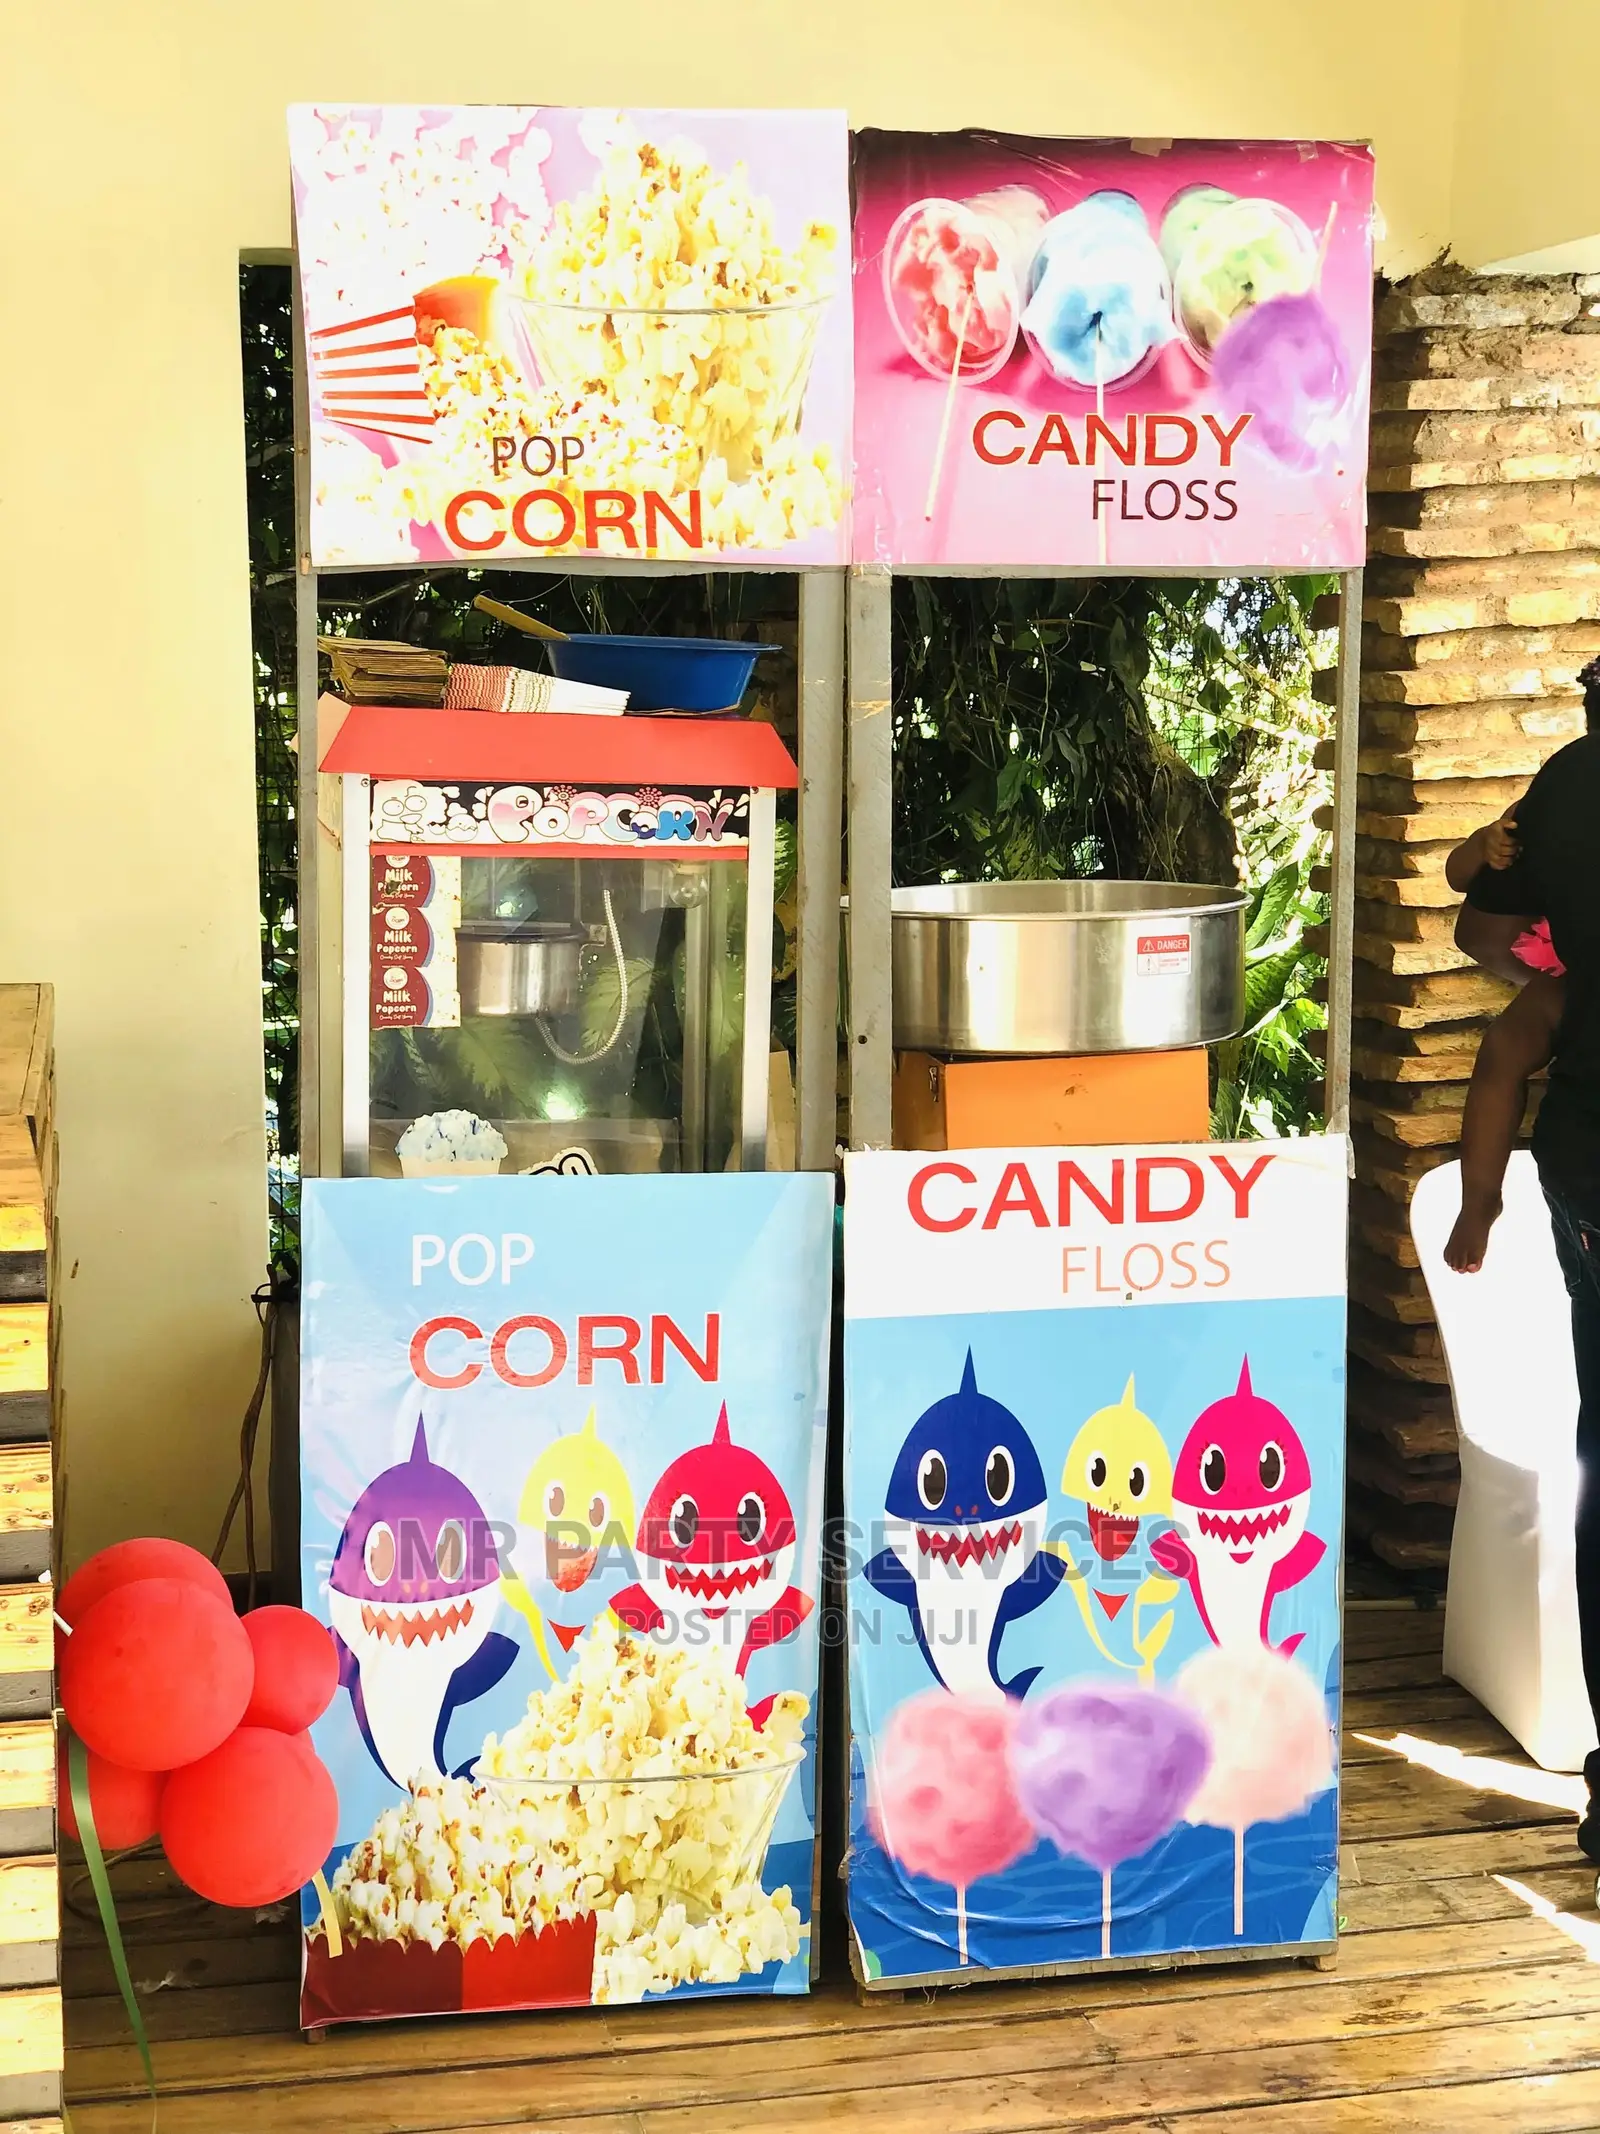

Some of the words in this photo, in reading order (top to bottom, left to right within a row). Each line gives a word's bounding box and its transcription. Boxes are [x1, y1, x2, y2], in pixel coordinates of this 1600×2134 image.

[492, 436, 585, 477] POP
[972, 410, 1253, 467] CANDY
[444, 489, 704, 551] CORN
[1092, 479, 1238, 521] FLOSS
[385, 868, 413, 883] Milk
[376, 943, 418, 955] Popcorn
[384, 930, 412, 943] Milk
[1157, 938, 1188, 951] DANGER
[375, 1004, 417, 1015] Popcorn
[383, 990, 411, 1003] Milk
[907, 1155, 1277, 1233] CANDY
[411, 1233, 535, 1287] POP
[1061, 1240, 1231, 1294] FLOSS
[408, 1312, 722, 1391] CORN
